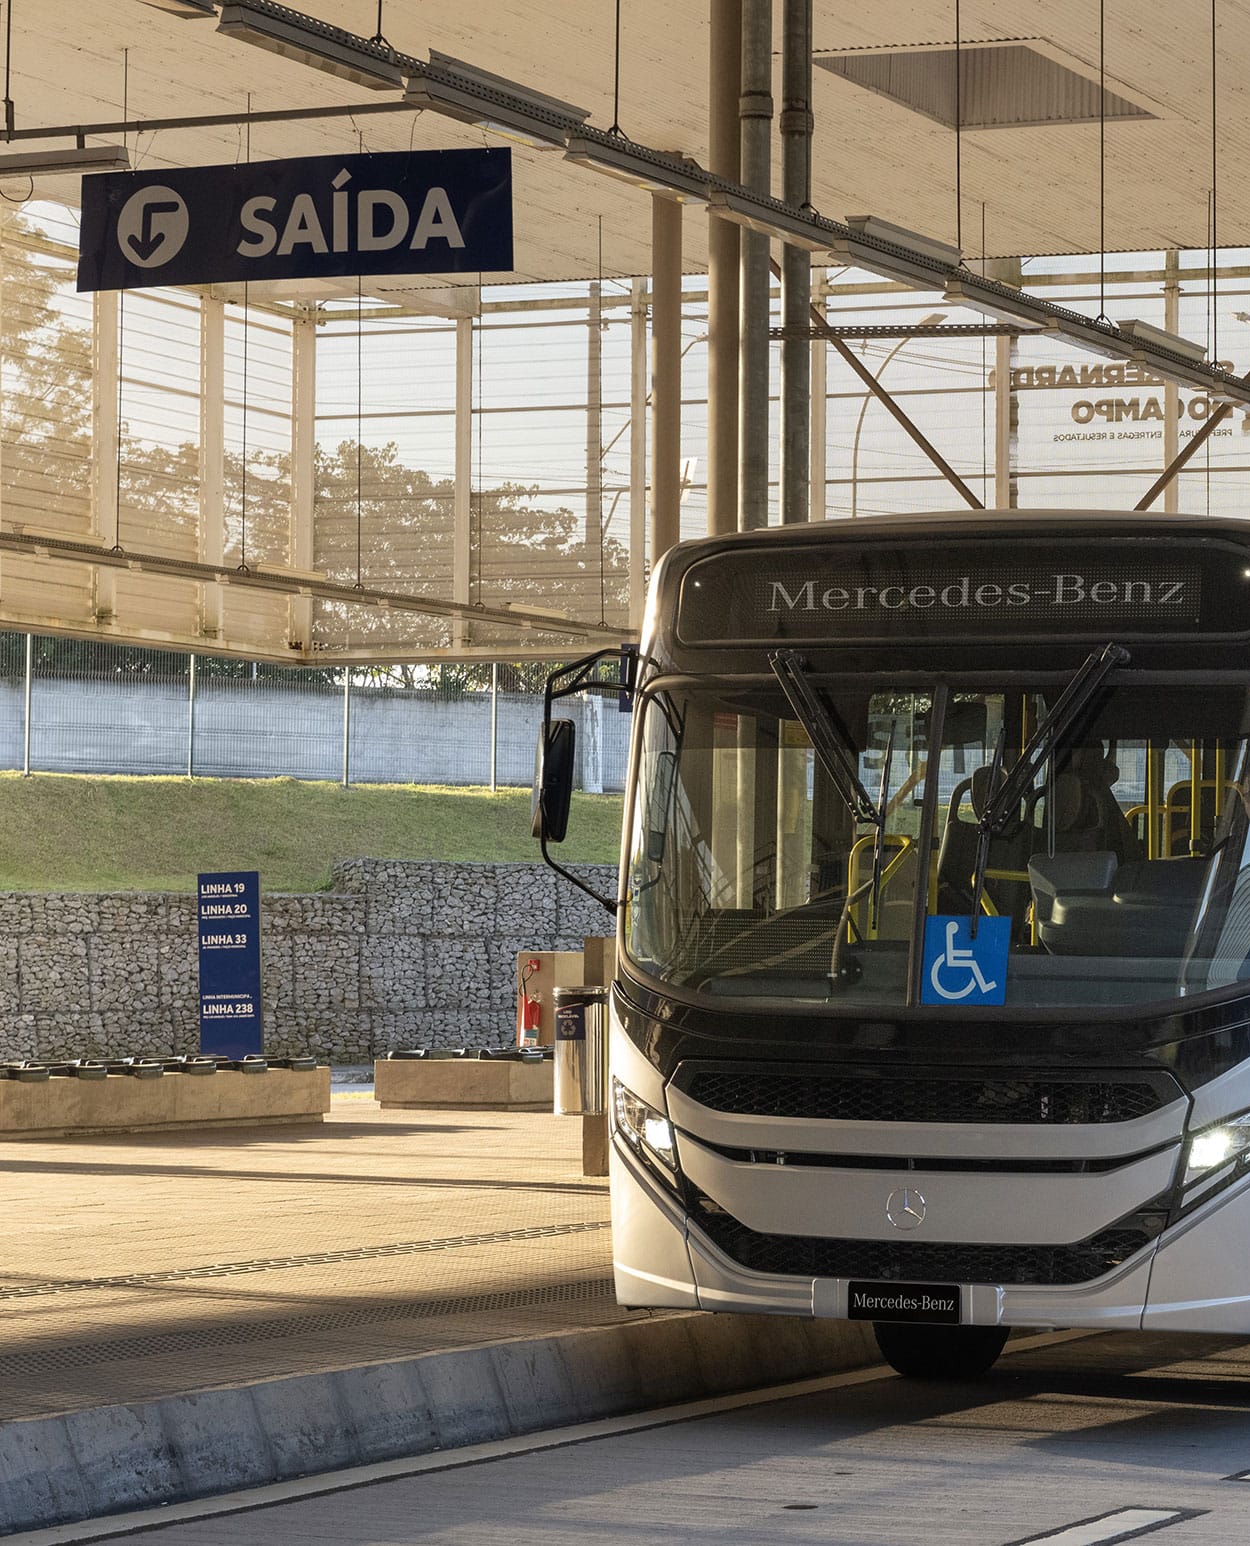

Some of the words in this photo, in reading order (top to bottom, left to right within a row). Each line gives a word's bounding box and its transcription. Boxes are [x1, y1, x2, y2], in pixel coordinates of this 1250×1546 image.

[236, 167, 466, 258] SAÍDA
[767, 574, 1185, 612] Mercedes-Benz
[201, 884, 232, 894] LINHA
[234, 883, 245, 893] 19
[201, 905, 232, 915] LINHA
[234, 904, 247, 914] 20
[202, 935, 233, 945] LINHA
[235, 934, 247, 944] 33
[203, 1004, 234, 1014] LINHA
[236, 1003, 253, 1013] 238
[853, 1293, 954, 1311] Mercedes-Benz
